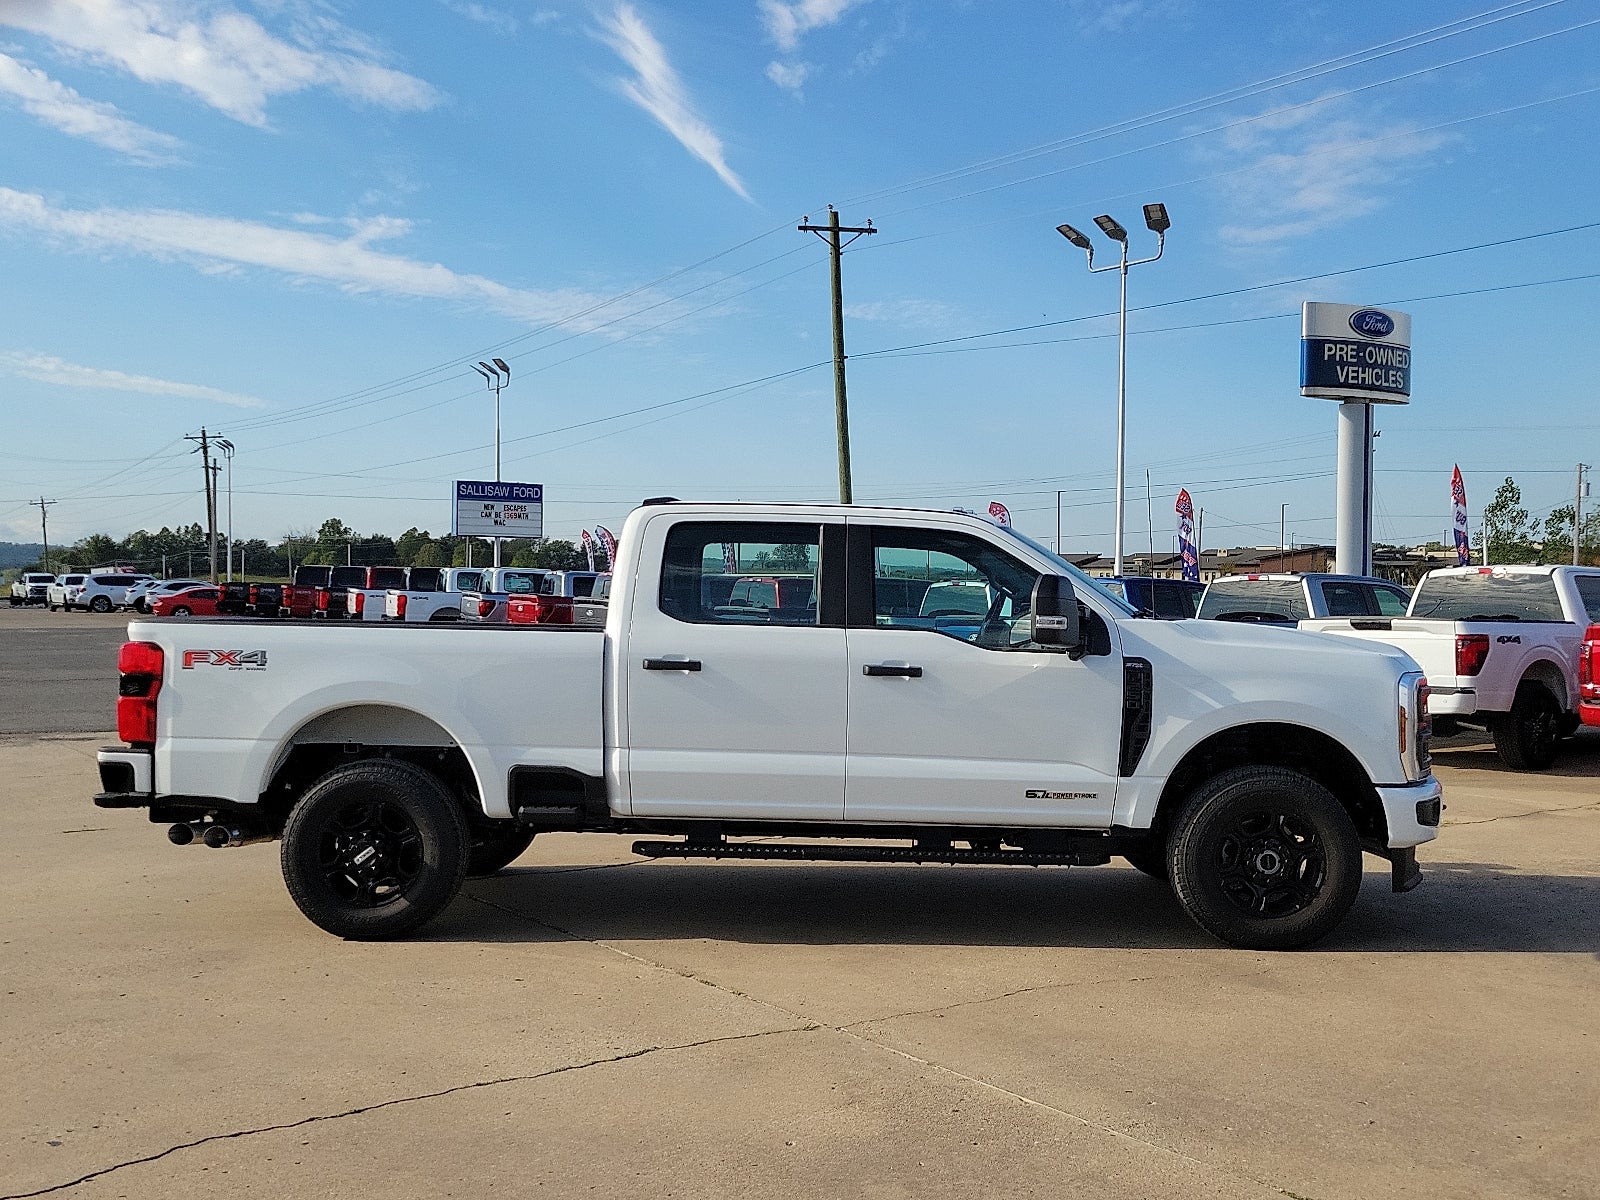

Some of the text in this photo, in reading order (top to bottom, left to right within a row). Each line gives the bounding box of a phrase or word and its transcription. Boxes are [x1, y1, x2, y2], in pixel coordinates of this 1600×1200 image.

[1363, 314, 1388, 333] Ford
[1336, 365, 1404, 389] VEHICLES
[460, 484, 541, 499] SALLISAW FORD
[483, 503, 528, 512] NEW ESCAPES
[494, 511, 502, 519] BE
[182, 650, 268, 669] FX4
